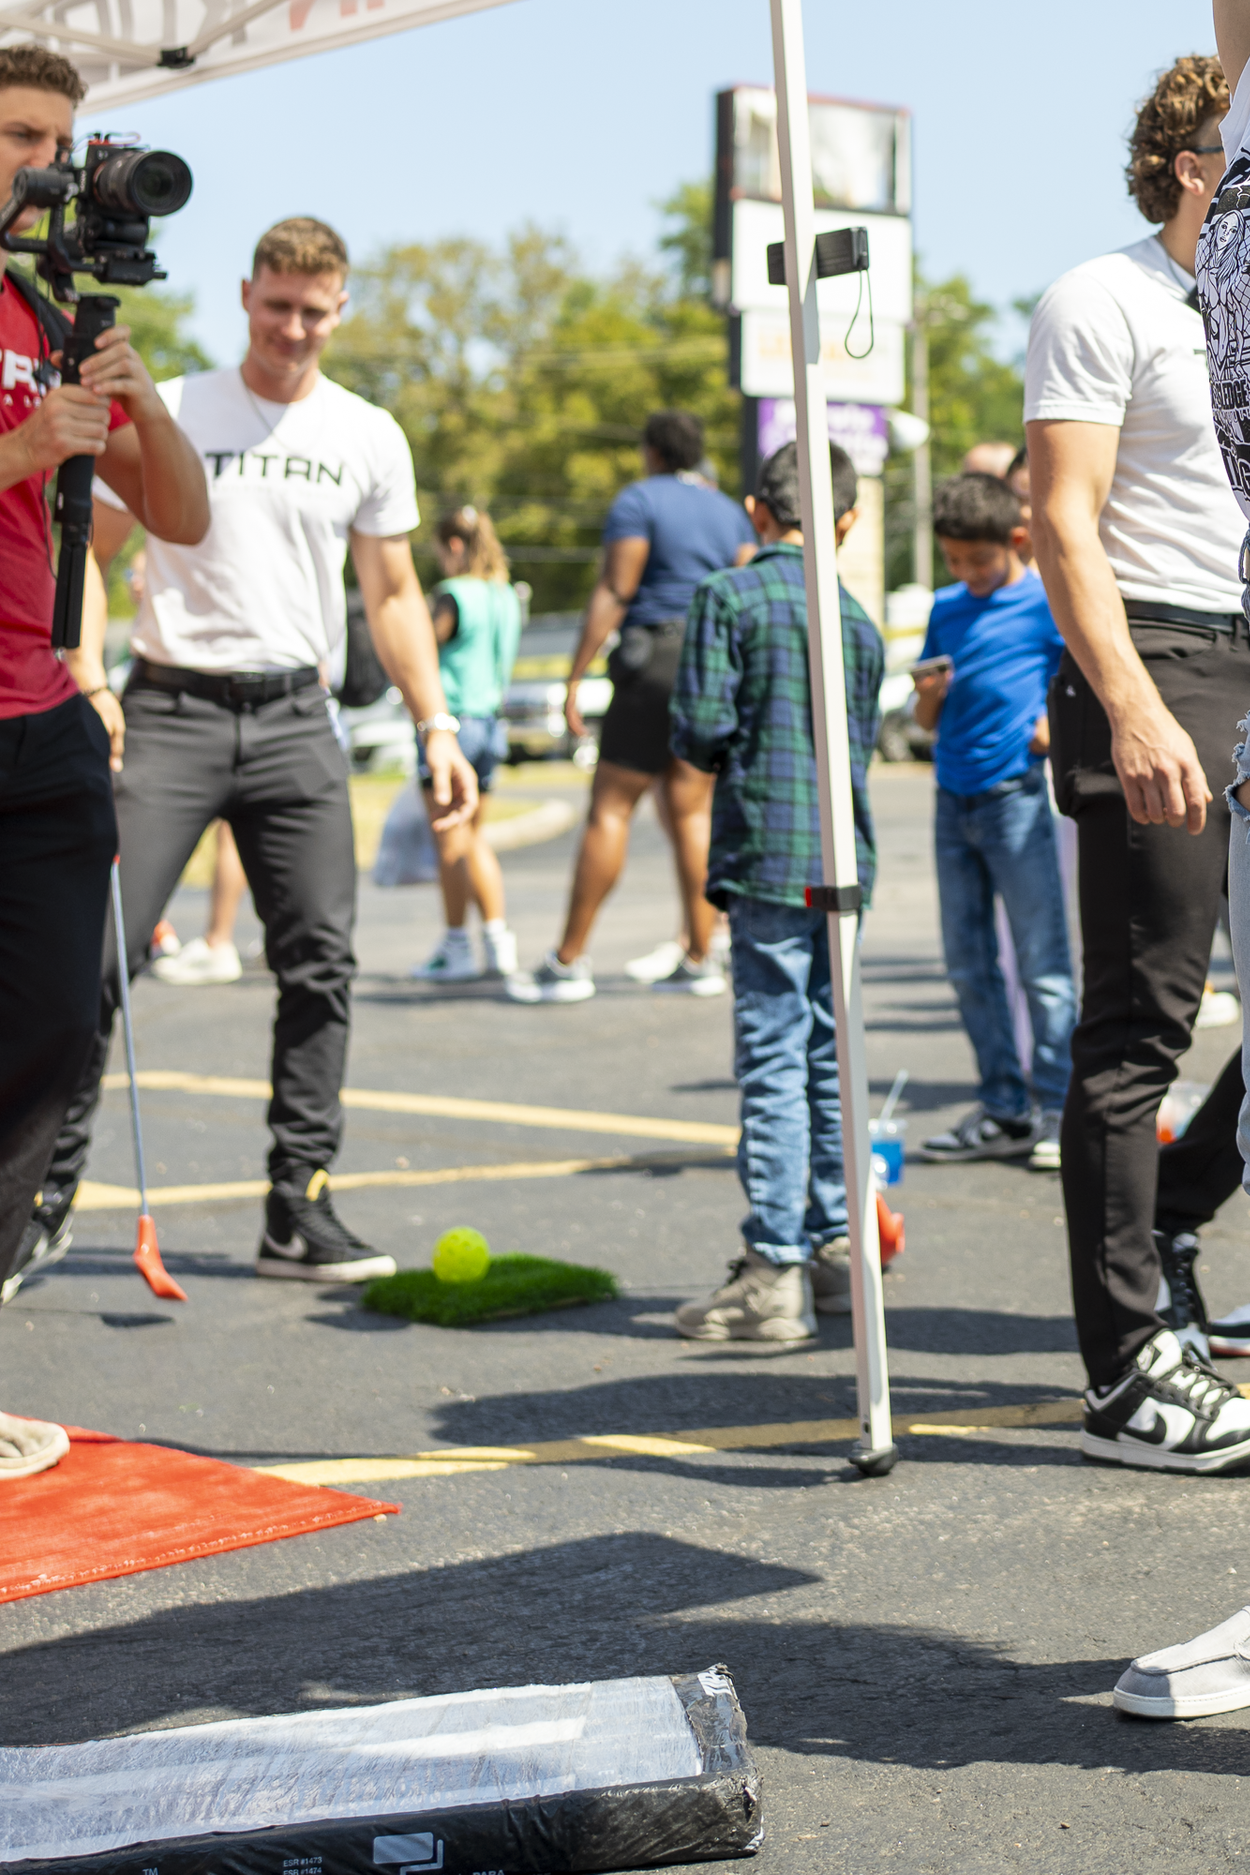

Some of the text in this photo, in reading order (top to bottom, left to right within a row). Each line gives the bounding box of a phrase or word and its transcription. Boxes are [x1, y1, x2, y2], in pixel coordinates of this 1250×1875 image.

[204, 450, 346, 487] TITAN
[283, 1856, 322, 1867] ESR #1473
[300, 1866, 322, 1875] #1474
